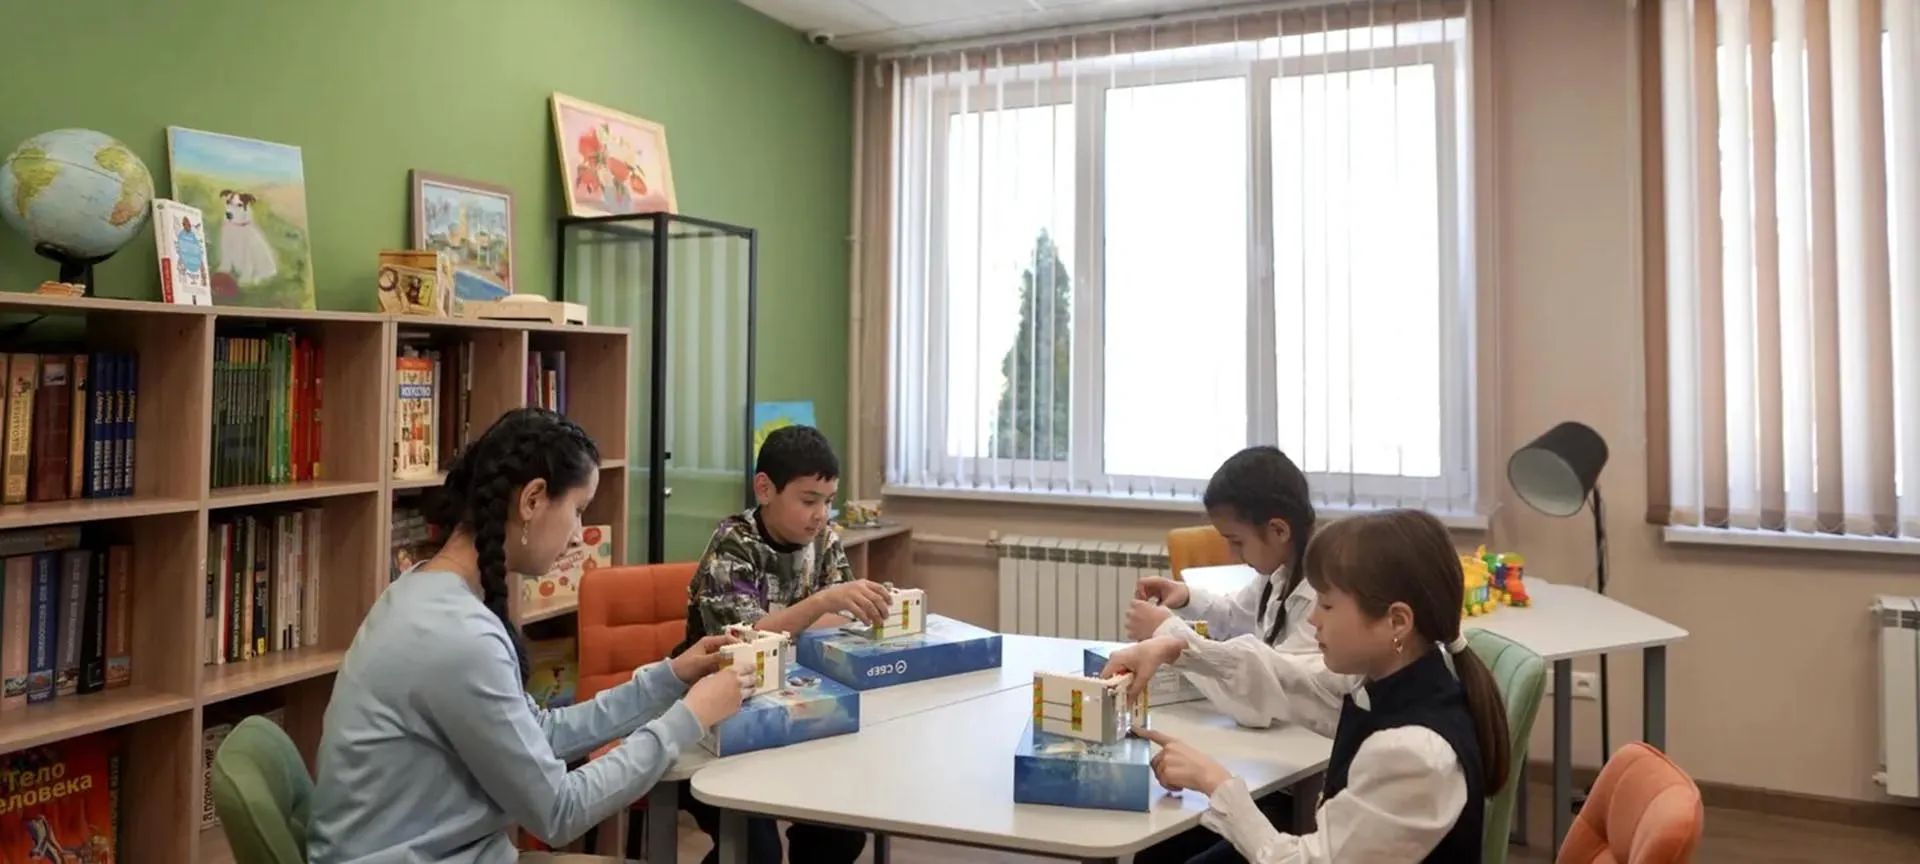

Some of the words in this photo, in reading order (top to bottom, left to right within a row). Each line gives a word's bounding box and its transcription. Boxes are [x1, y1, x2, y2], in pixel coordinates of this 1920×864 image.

[94, 391, 103, 425] Почему?
[866, 663, 894, 677] СБЕР
[6, 762, 66, 793] Тело
